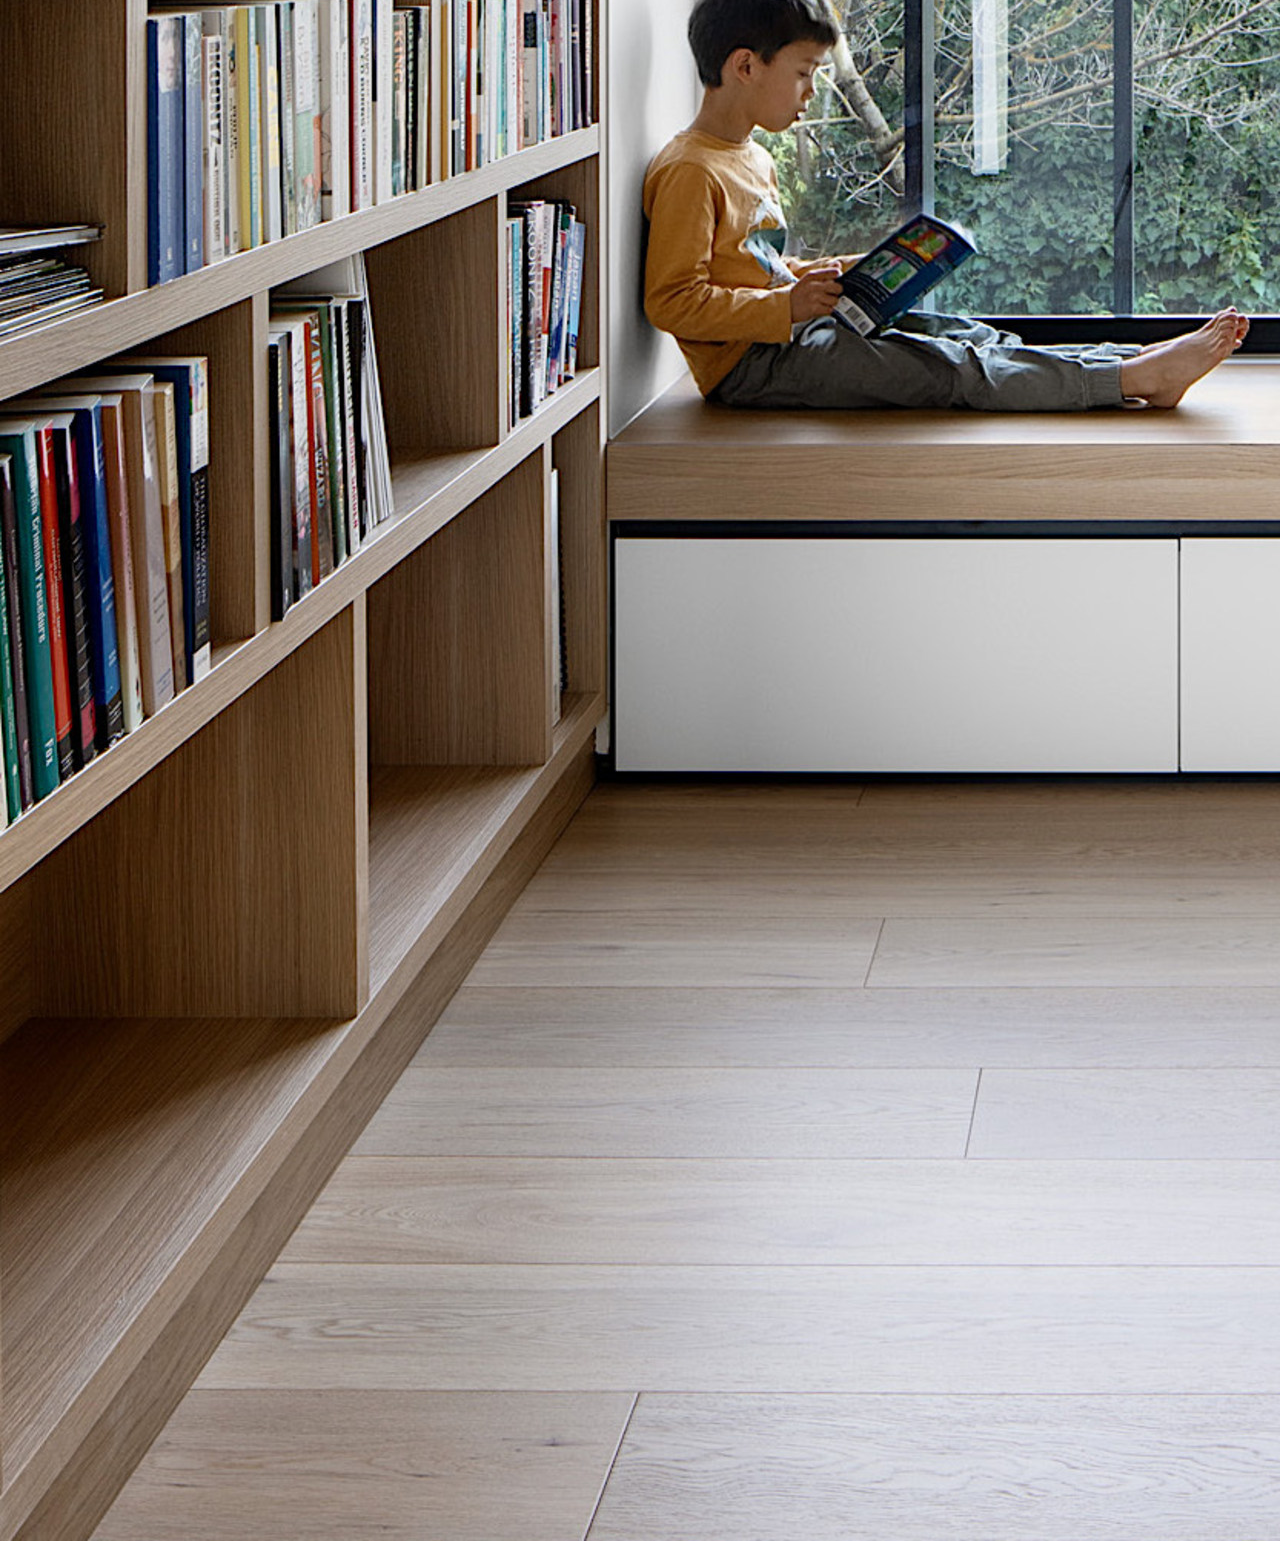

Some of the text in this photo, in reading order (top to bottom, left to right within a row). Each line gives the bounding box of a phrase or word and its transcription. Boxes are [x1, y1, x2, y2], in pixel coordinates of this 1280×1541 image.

[393, 28, 404, 84] KING
[208, 51, 222, 146] KOONTZ
[527, 220, 537, 301] KOONTZ
[571, 254, 582, 302] Japan
[310, 327, 323, 400] KING
[32, 516, 42, 571] Criminal
[36, 573, 46, 643] Procedure
[44, 737, 54, 767] Fox
